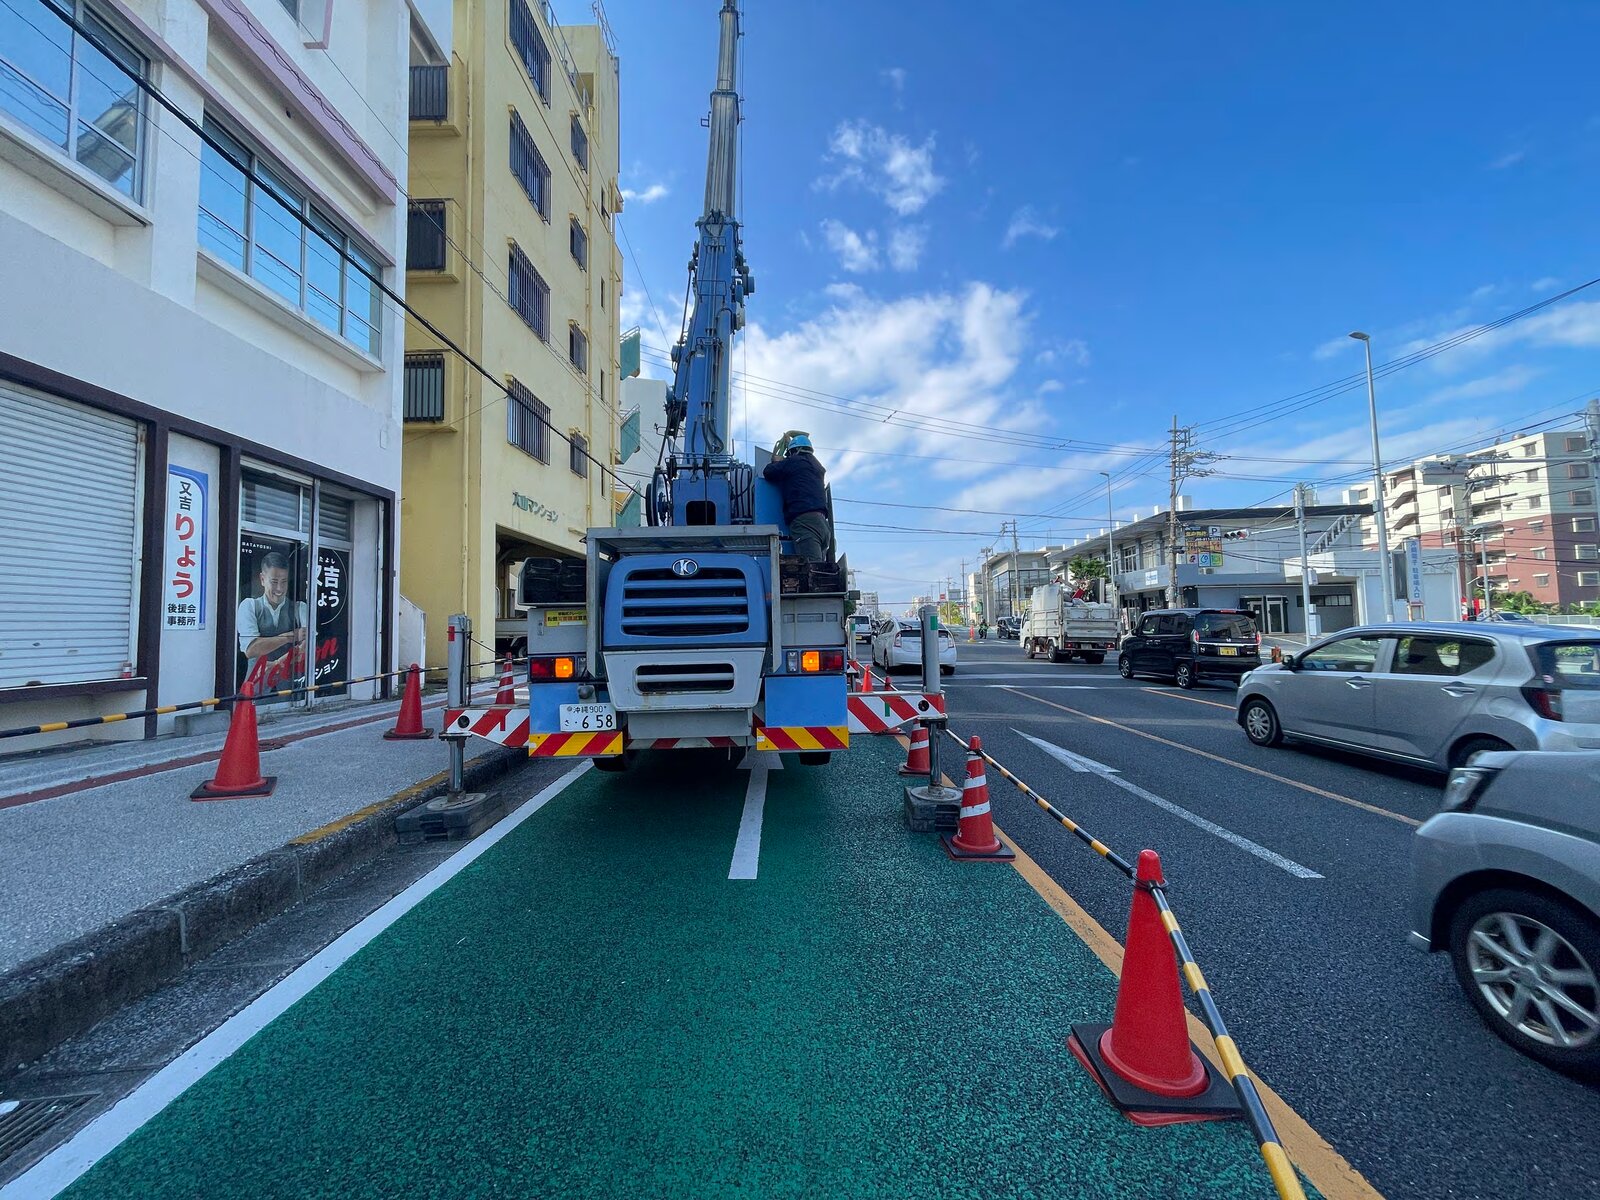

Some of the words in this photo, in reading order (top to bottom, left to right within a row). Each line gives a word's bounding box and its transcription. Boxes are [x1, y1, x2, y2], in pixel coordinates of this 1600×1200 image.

[167, 603, 197, 614] 後援会
[167, 615, 196, 627] 事務所
